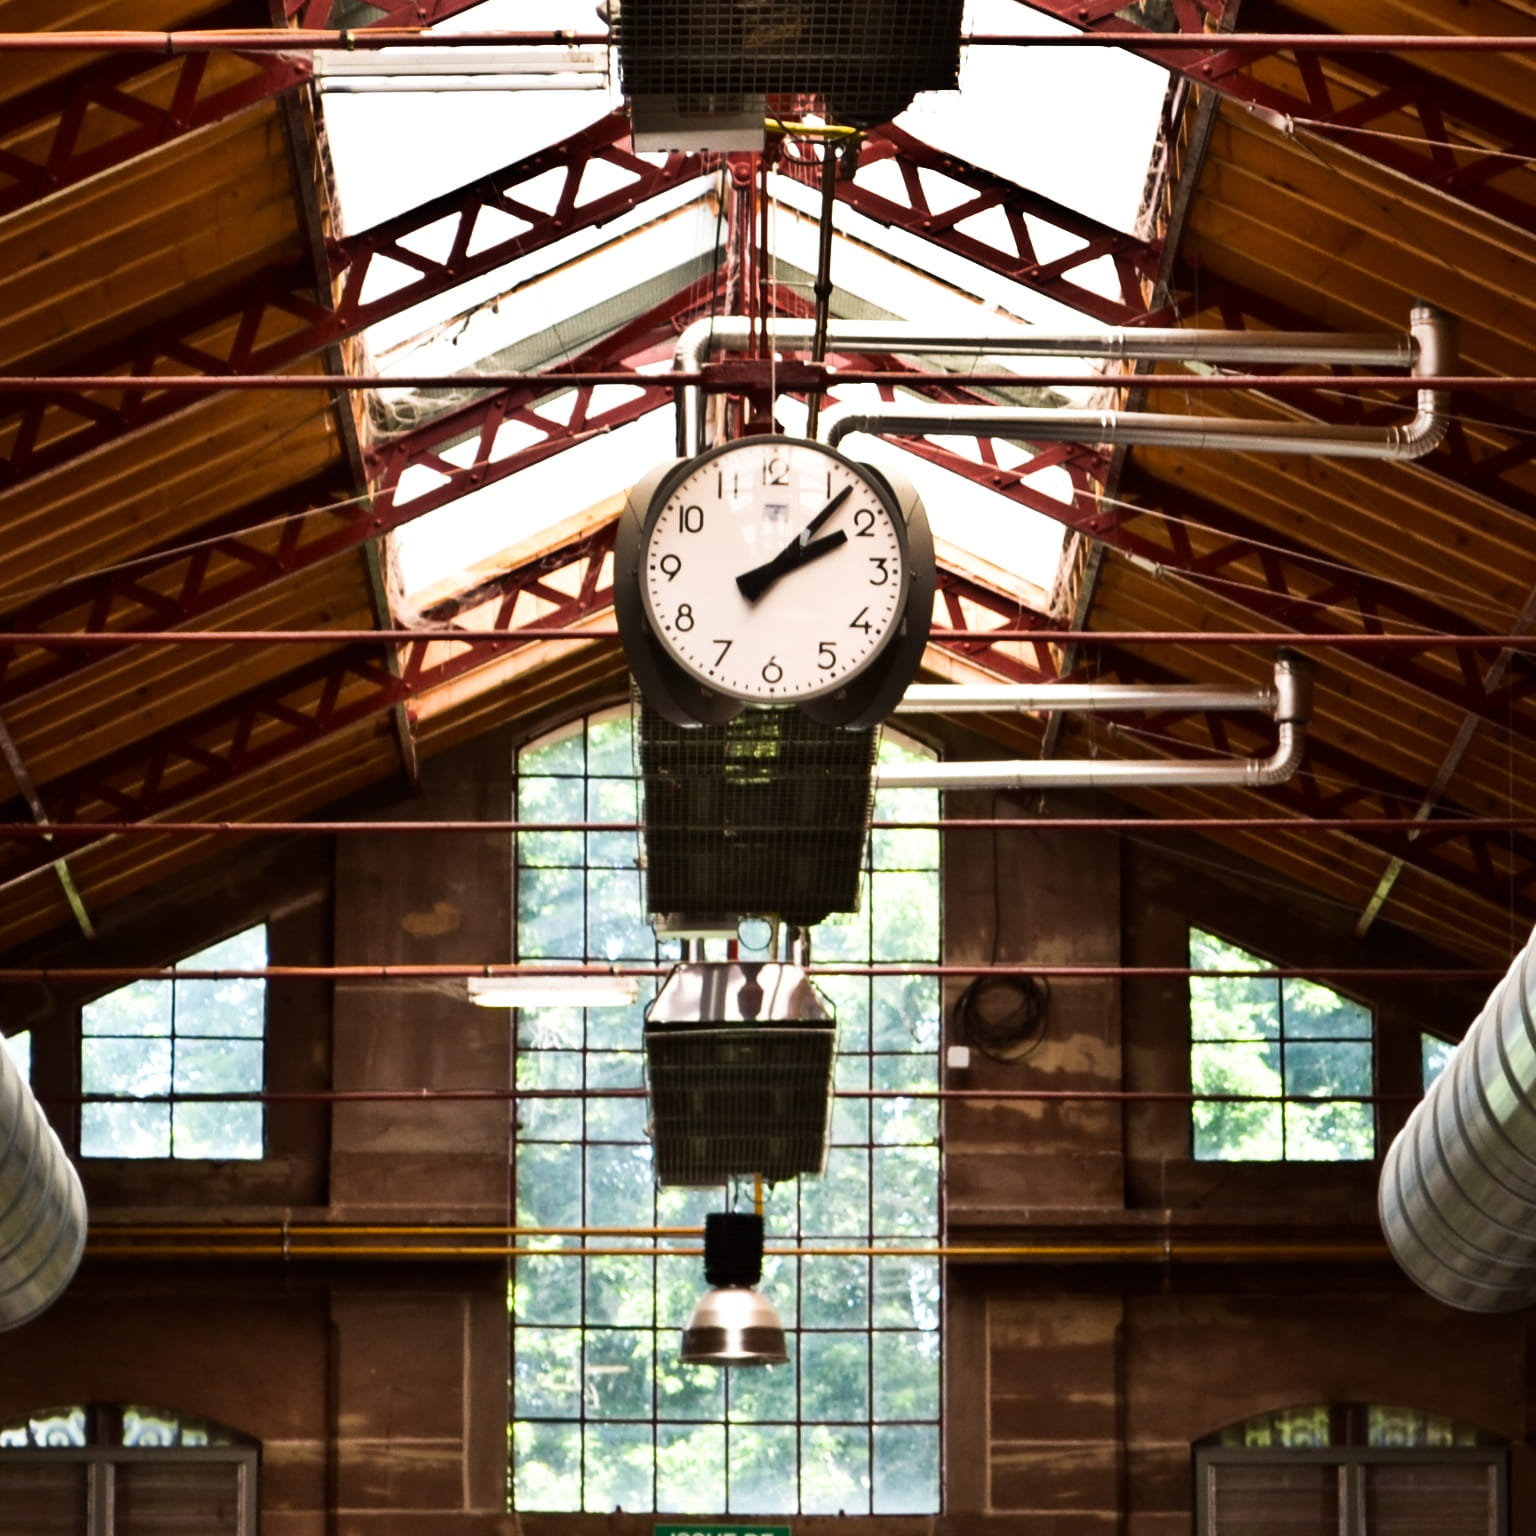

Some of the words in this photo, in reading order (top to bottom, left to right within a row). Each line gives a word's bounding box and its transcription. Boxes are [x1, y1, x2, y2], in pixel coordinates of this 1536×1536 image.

[717, 471, 739, 500] 11
[762, 458, 789, 486] 12
[827, 472, 831, 499] 1
[679, 505, 704, 533] 10
[854, 509, 876, 537] 2
[660, 554, 682, 582] 9
[869, 557, 888, 586] 3
[675, 603, 694, 632] 8
[849, 607, 872, 635] 4
[713, 640, 733, 667] 7
[818, 642, 837, 670] 5
[762, 655, 783, 684] 6
